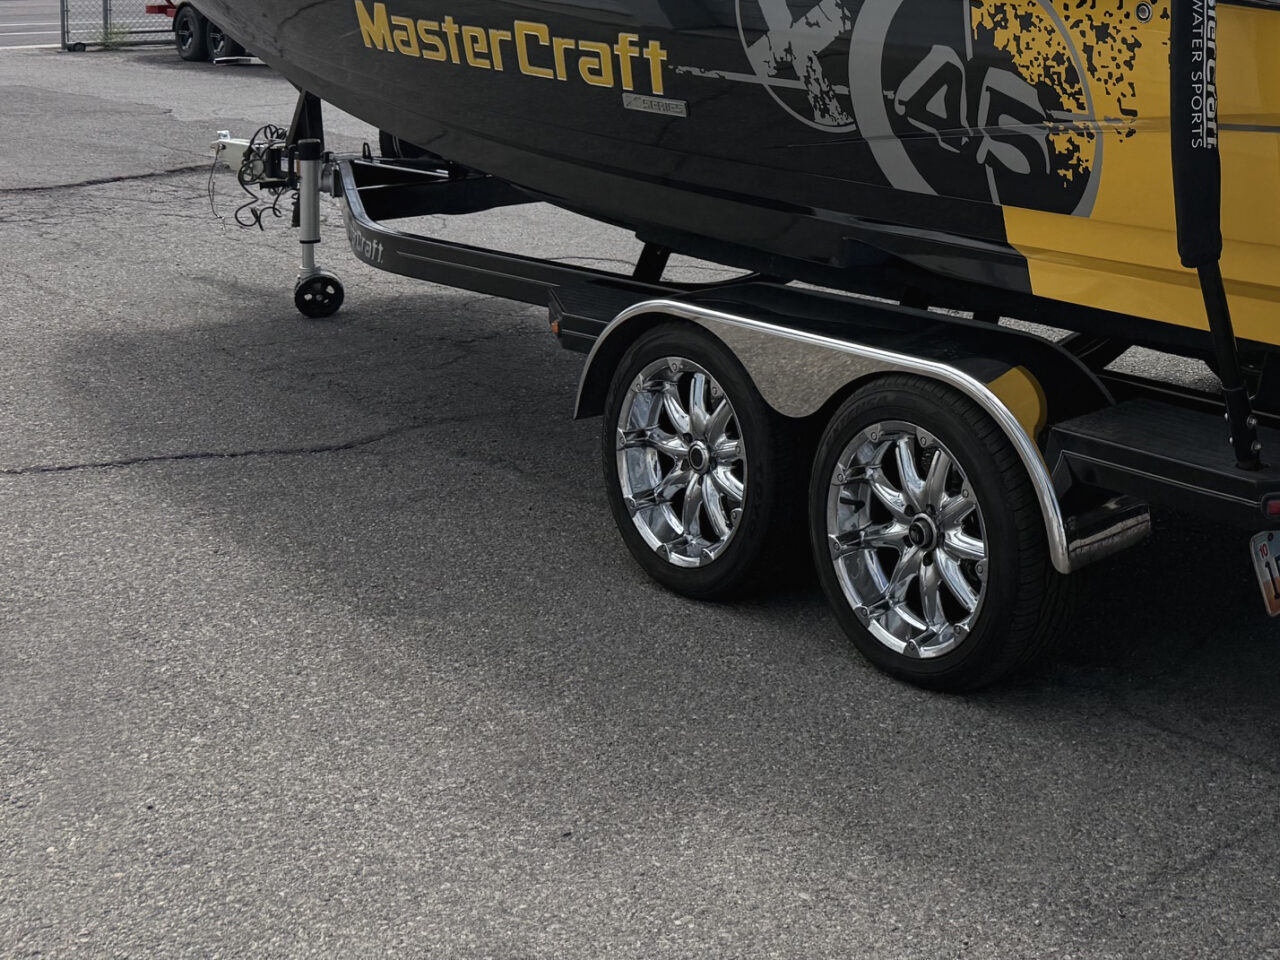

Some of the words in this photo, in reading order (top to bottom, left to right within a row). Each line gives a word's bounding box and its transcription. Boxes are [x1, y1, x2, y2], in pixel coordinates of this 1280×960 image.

[354, 0, 668, 96] MasterCraft
[1191, 71, 1203, 149] SPORTS
[1258, 543, 1269, 558] 10
